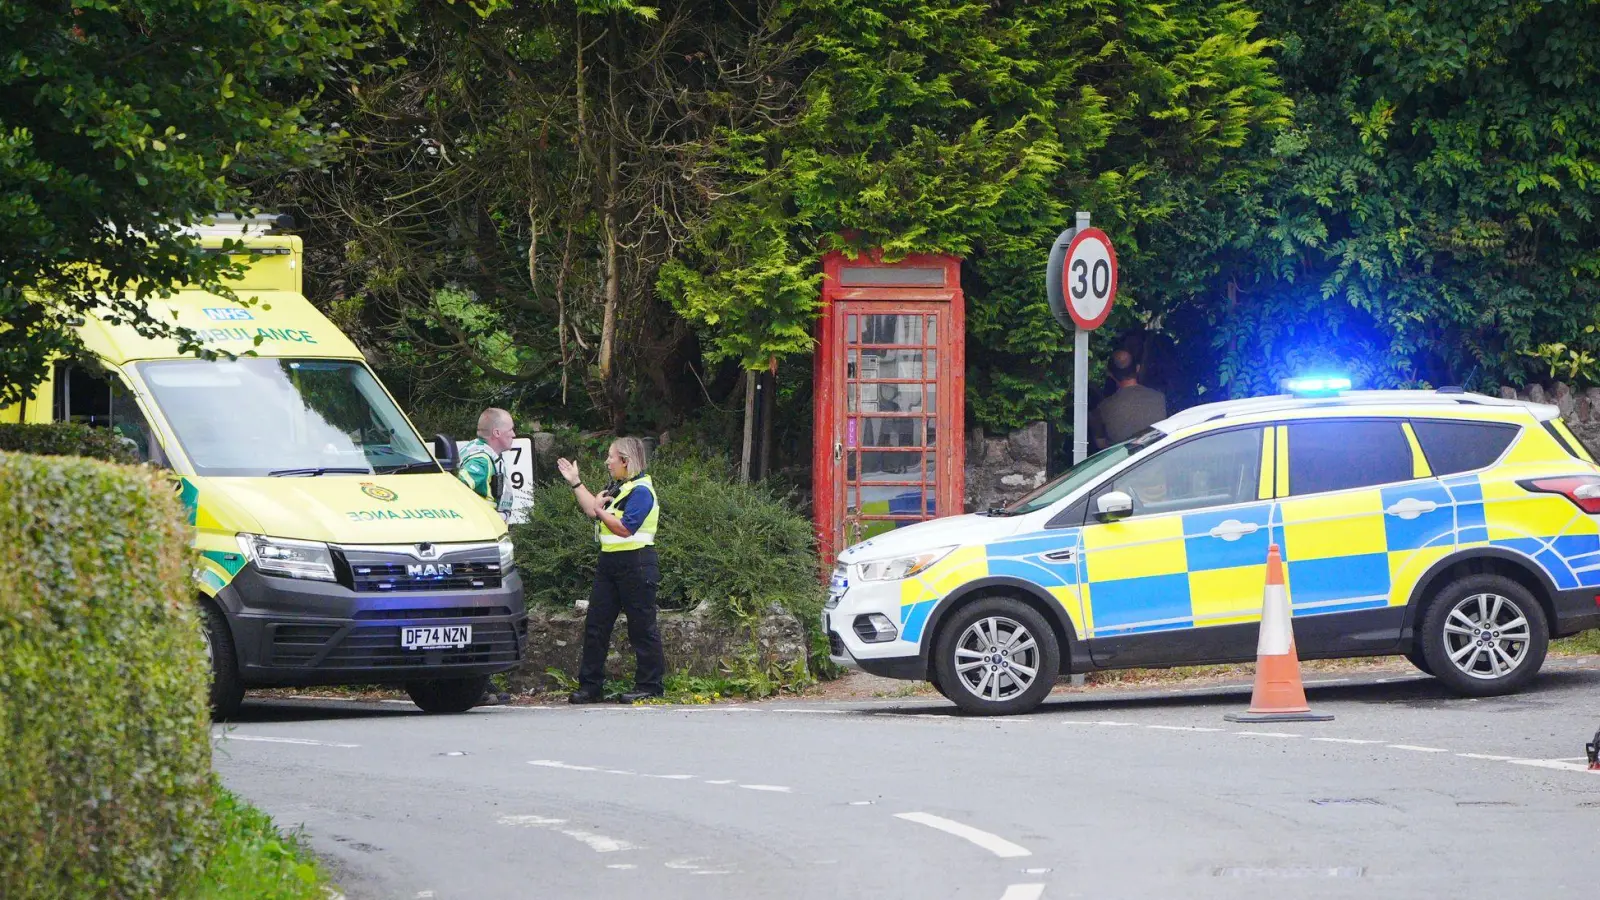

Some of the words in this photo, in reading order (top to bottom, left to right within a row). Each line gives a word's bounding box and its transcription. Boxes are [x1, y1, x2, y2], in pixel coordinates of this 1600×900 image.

[1071, 258, 1110, 299] 30
[206, 308, 251, 320] NHS
[194, 327, 318, 344] MBULANCE
[510, 447, 522, 465] 7
[510, 471, 525, 490] 9
[407, 563, 453, 576] MAN
[406, 628, 440, 645] DF74
[443, 627, 468, 643] NZN
